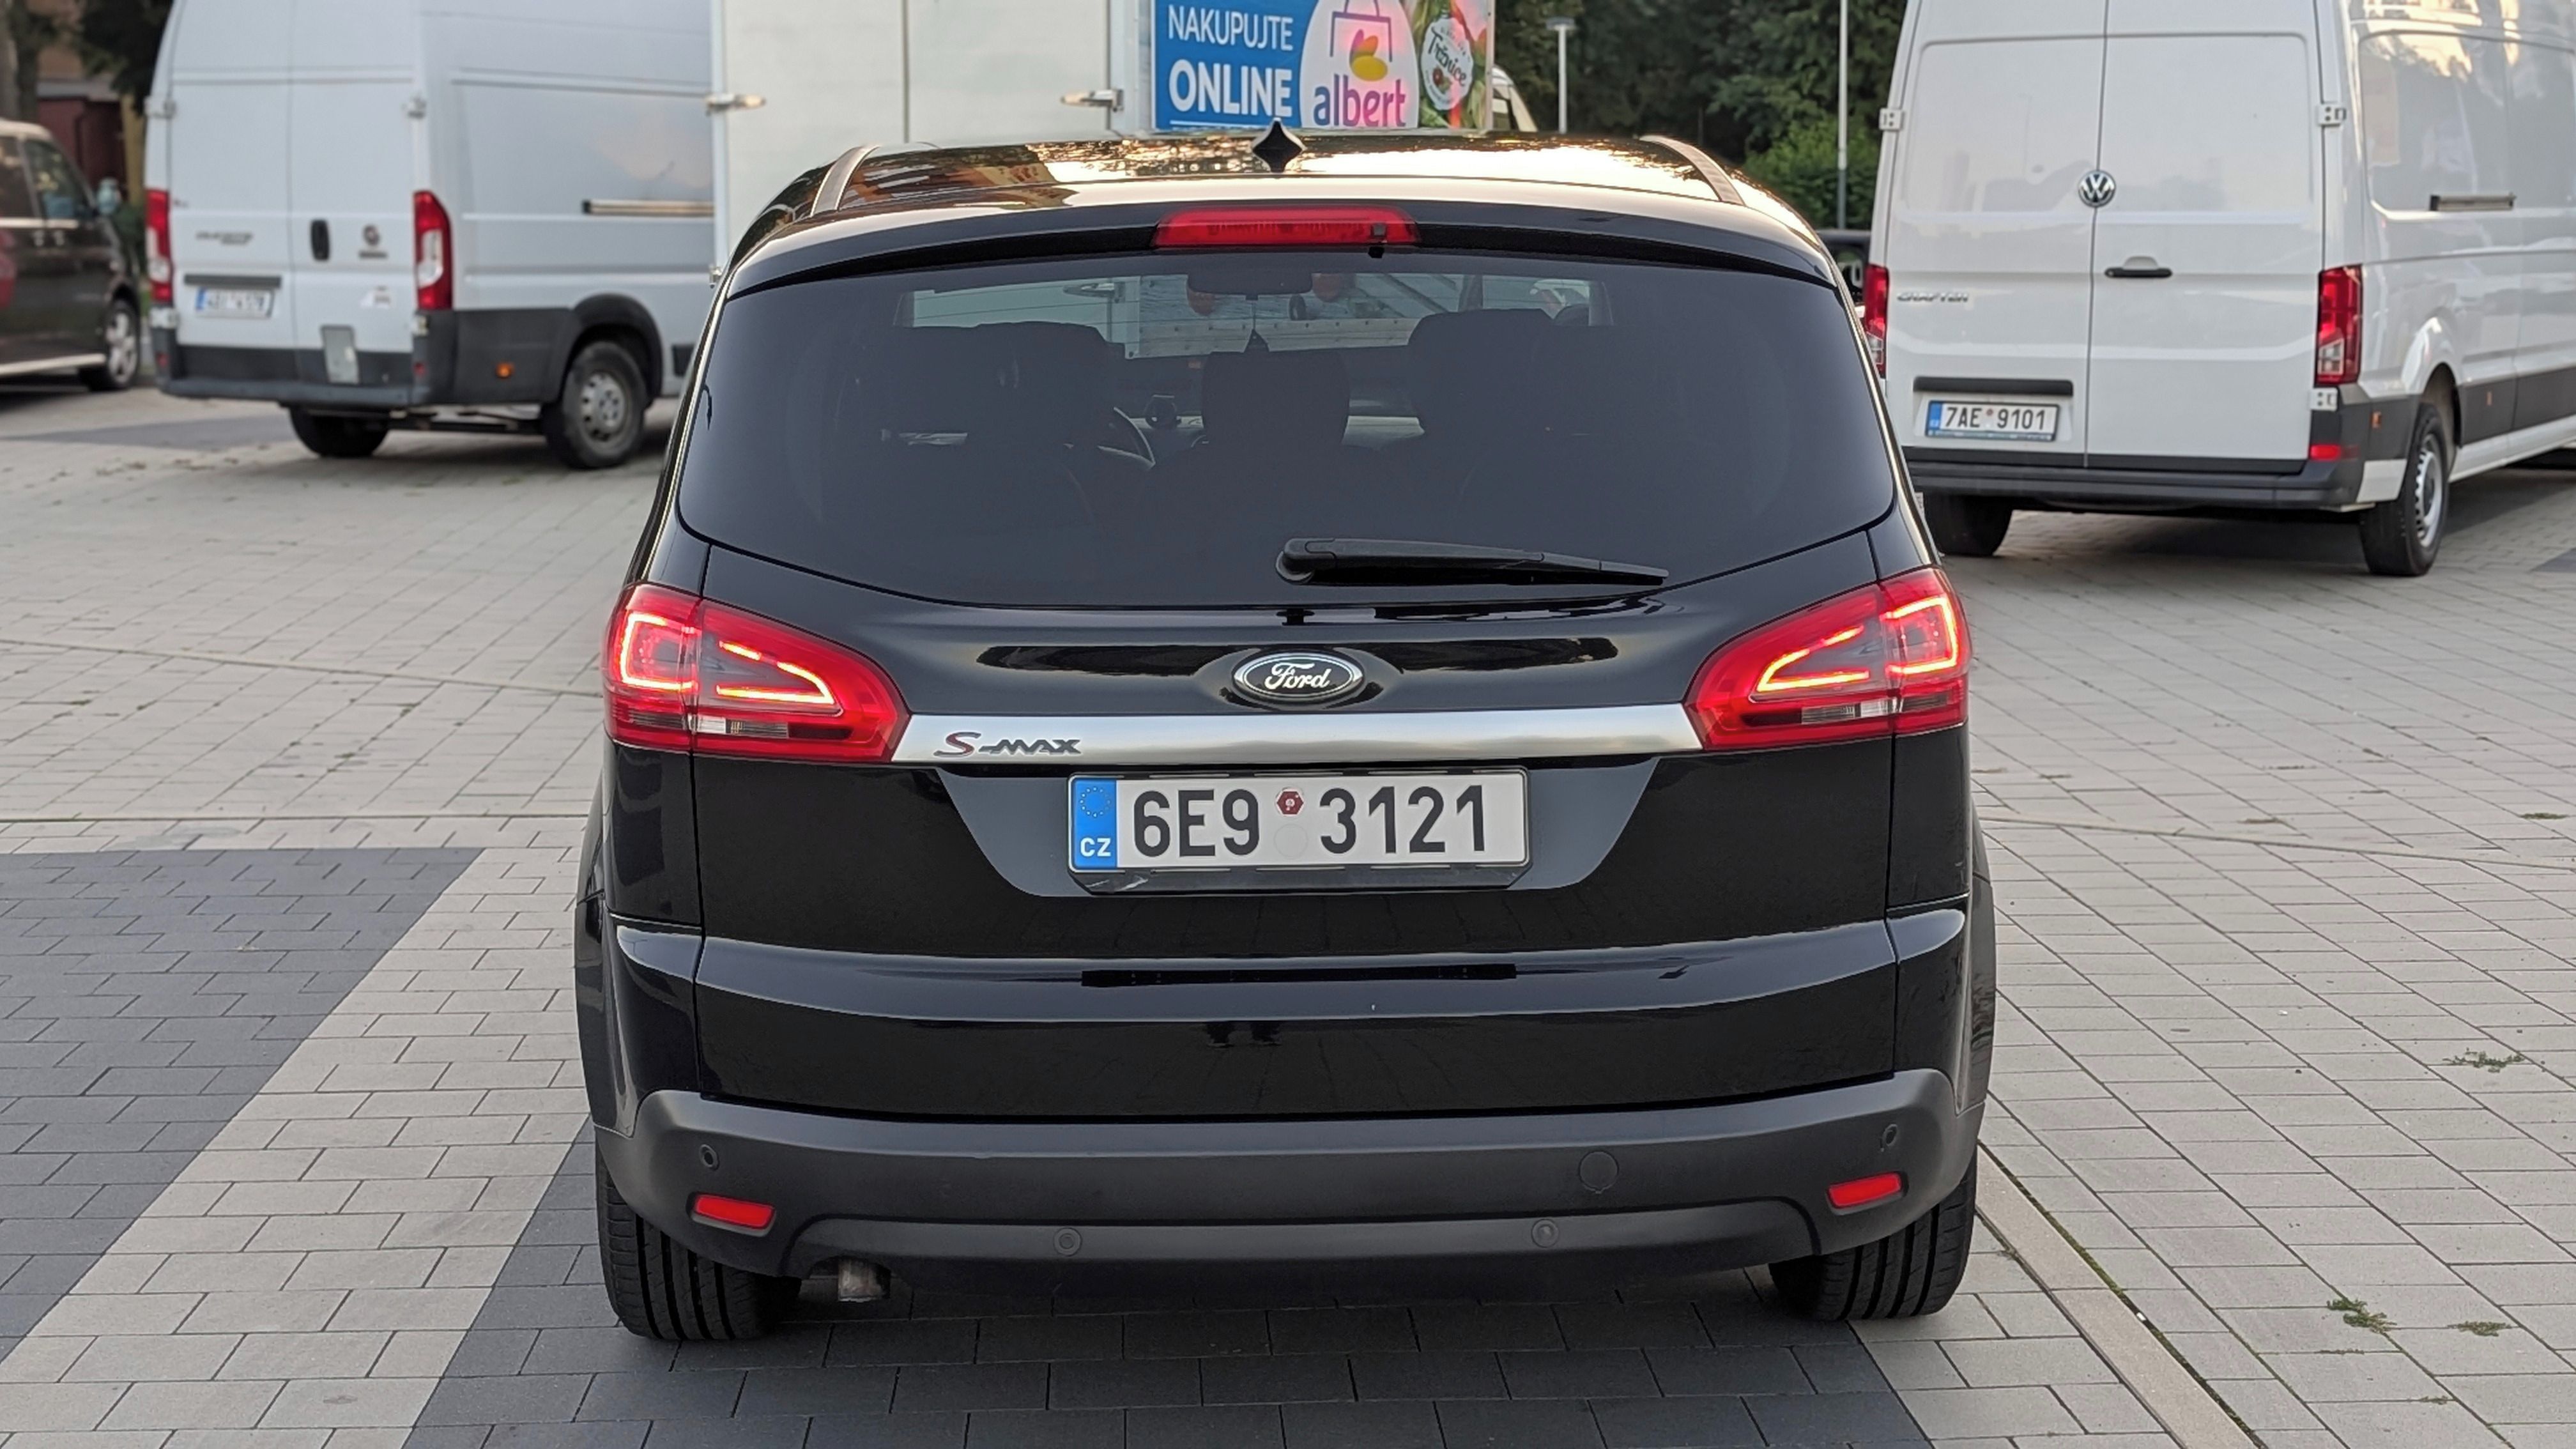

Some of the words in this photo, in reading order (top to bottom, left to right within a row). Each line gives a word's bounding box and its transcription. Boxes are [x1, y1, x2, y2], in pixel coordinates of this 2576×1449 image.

[1169, 4, 1293, 51] NAKUPUJTE
[1169, 59, 1292, 118] ONLINE
[1314, 73, 1406, 127] albert
[1946, 407, 1982, 427] 7AE
[1997, 408, 2045, 430] 9101
[1264, 662, 1332, 690] Ford
[1133, 790, 1259, 857] 6E9
[1319, 785, 1486, 854] 3121
[1080, 837, 1112, 857] CZ
